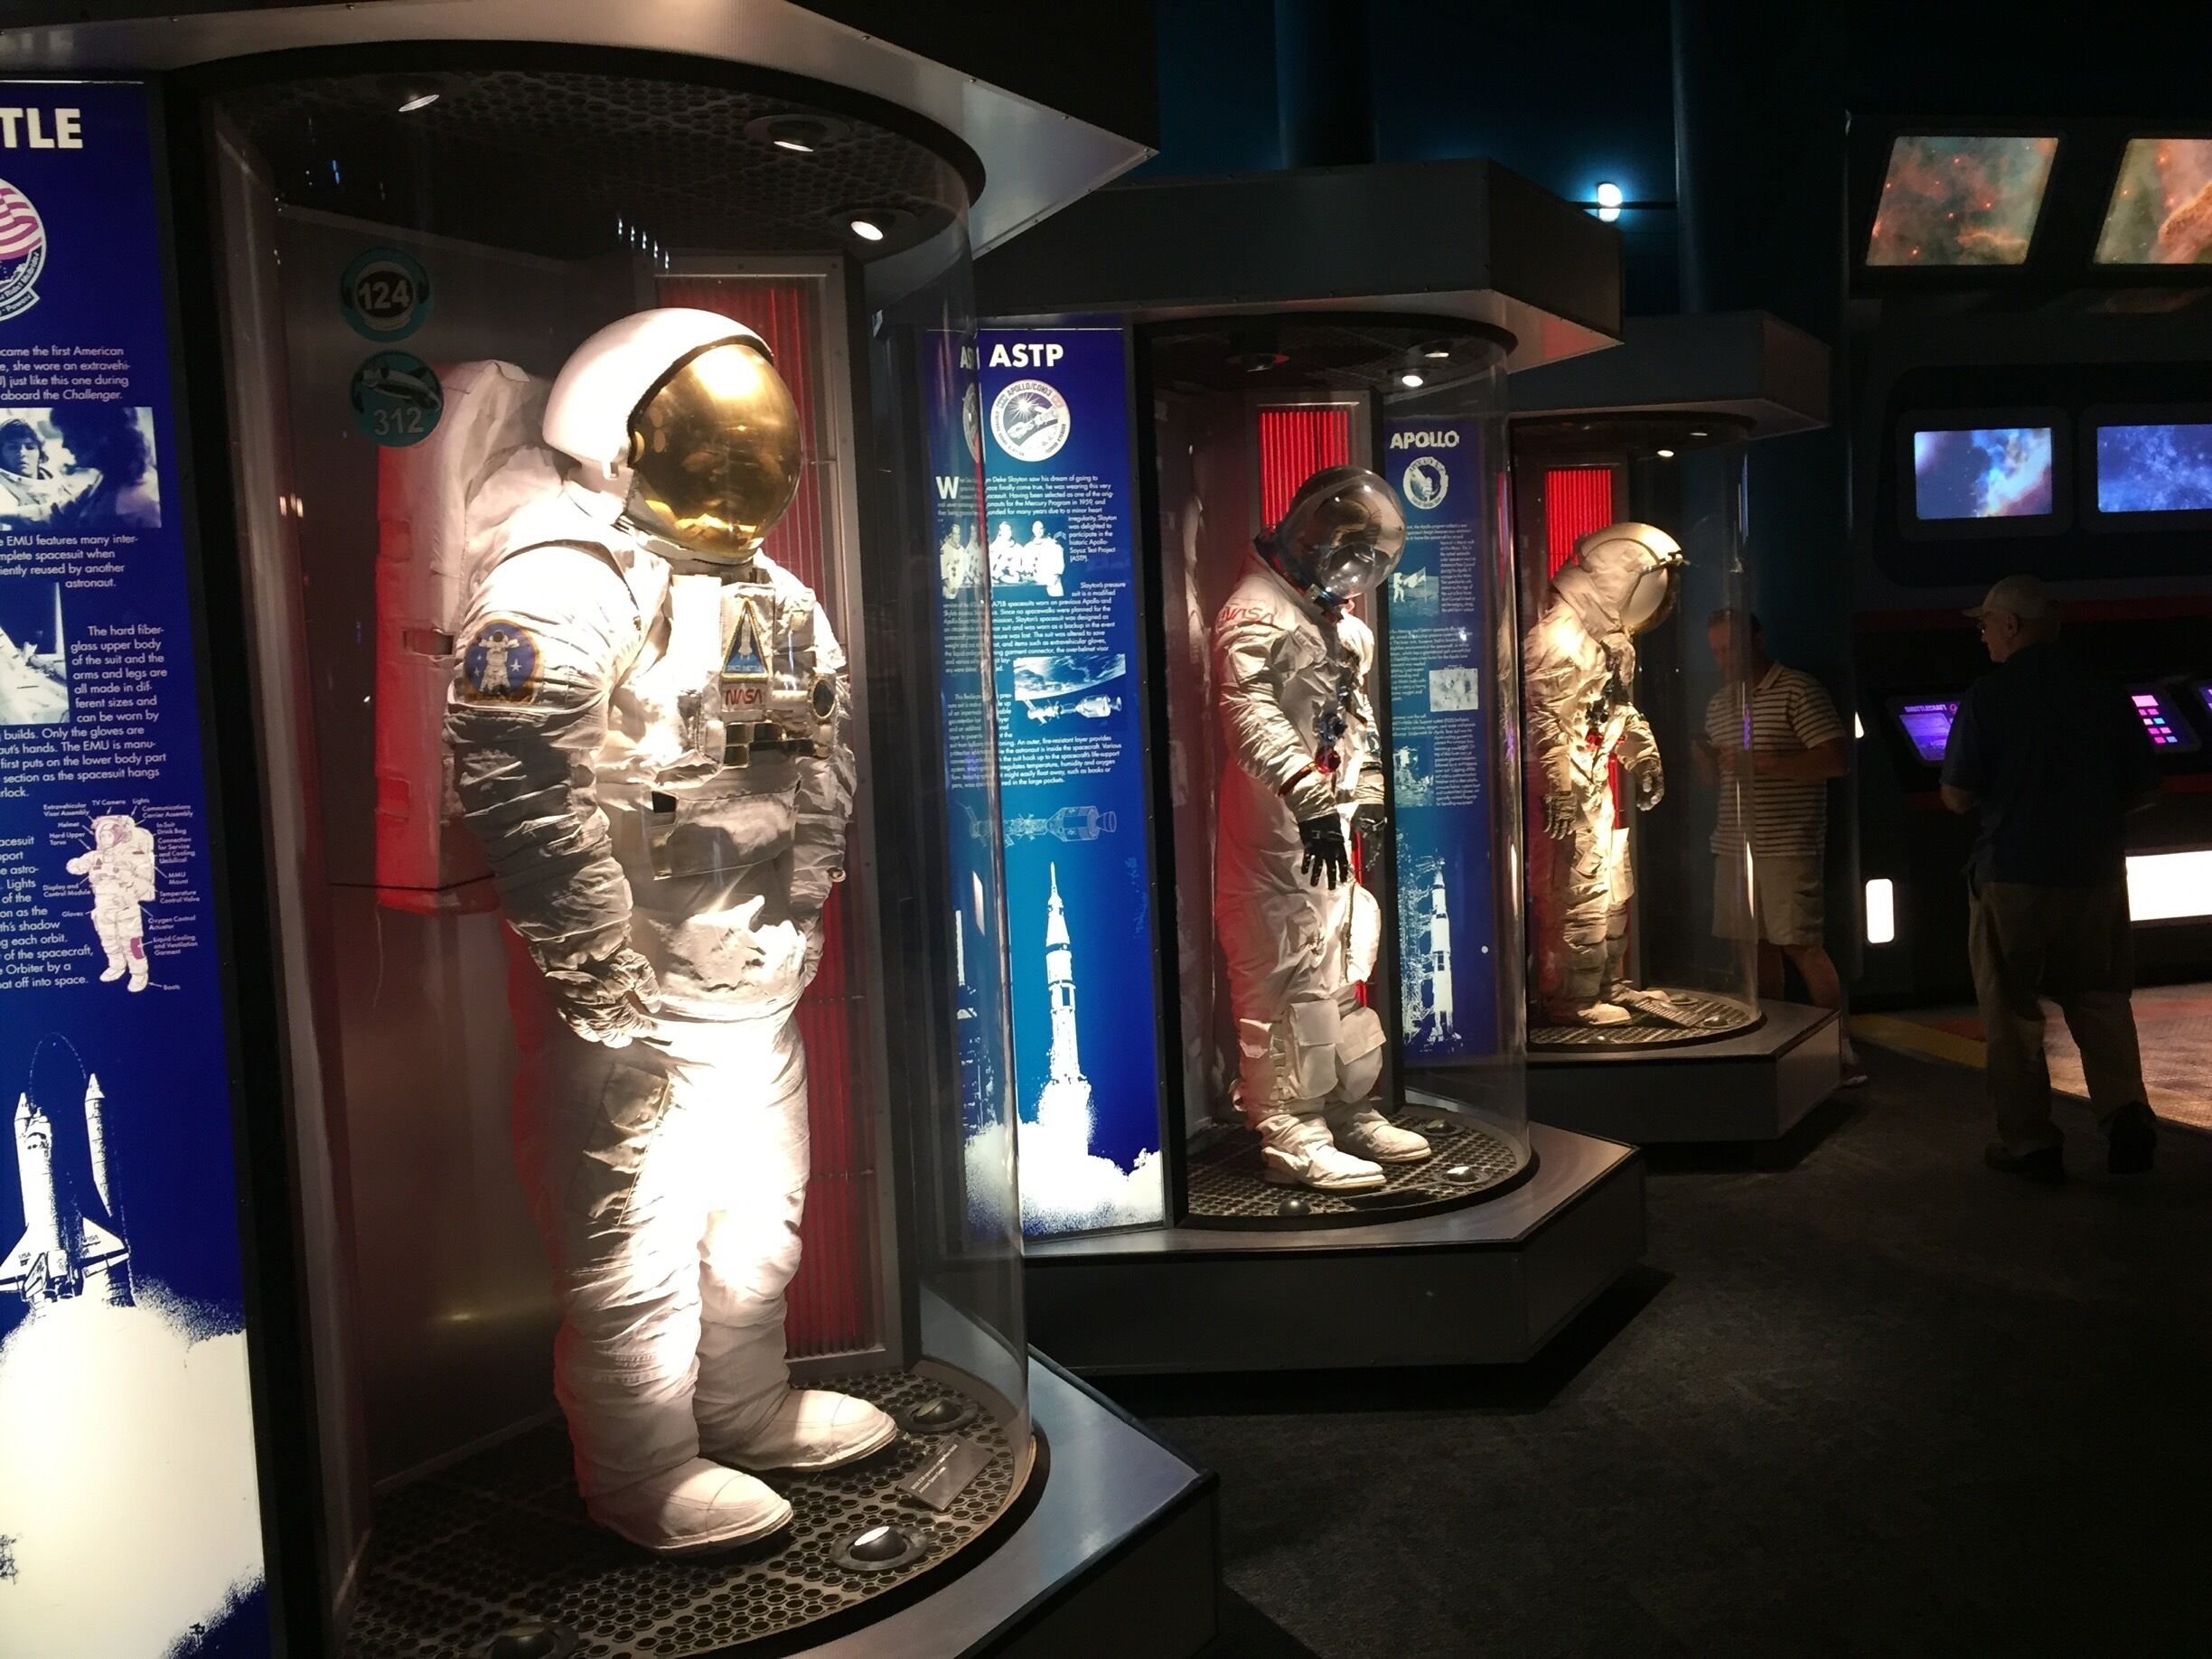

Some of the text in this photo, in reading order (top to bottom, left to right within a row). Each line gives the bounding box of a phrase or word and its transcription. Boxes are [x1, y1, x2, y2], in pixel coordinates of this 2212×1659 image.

[0, 108, 83, 149] TLE
[359, 280, 408, 309] 124
[33, 345, 49, 356] the
[52, 344, 70, 356] first
[73, 345, 124, 356] American
[989, 342, 1064, 368] ASTP
[13, 360, 31, 371] she
[80, 360, 130, 370] extravehi-
[9, 375, 27, 388] just
[30, 374, 48, 385] like
[51, 374, 70, 385] this
[95, 374, 129, 388] during
[1, 389, 123, 402] aboard the Challenger.
[373, 408, 424, 436] 312
[1390, 431, 1459, 449] APOLLO
[6, 535, 33, 547] EMU
[36, 534, 78, 546] features
[80, 537, 109, 547] many
[113, 534, 137, 544] inter-
[35, 549, 84, 562] spacesuit
[86, 548, 116, 559] when
[31, 563, 66, 575] reused
[69, 563, 82, 576] by
[85, 562, 126, 574] another
[65, 579, 117, 588] astronaut.
[1221, 606, 1273, 623] NASA
[88, 623, 164, 636] The hard fiber-
[70, 638, 162, 654] glass upper body
[71, 652, 164, 665] of the suit and the
[73, 667, 167, 680] arms and legs are
[74, 680, 153, 694] all made in dif-
[75, 695, 157, 708] ferent sizes and
[726, 689, 762, 705] NASA
[76, 709, 159, 723] can be worn by
[4, 726, 145, 740] builds. Only the gloves are
[22, 742, 58, 754] hands.
[61, 741, 80, 752] The
[83, 741, 109, 751] EMU
[112, 741, 121, 750] is
[124, 741, 156, 750] manu-
[0, 757, 19, 769] first
[22, 759, 44, 771] puts
[63, 755, 80, 766] the
[82, 754, 111, 765] lower
[114, 752, 142, 765] body
[145, 753, 166, 765] part
[3, 766, 160, 783] section as the spacesuit hangs
[10, 866, 40, 875] astro-
[6, 877, 36, 890] Lights
[2, 892, 32, 904] of the
[32, 905, 48, 916] the
[19, 919, 61, 931] shadow
[11, 933, 68, 945] each orbit.
[4, 944, 93, 961] of the spacecraft,
[5, 961, 71, 975] Orbiter by a
[14, 977, 30, 989] off
[32, 977, 52, 987] into
[54, 977, 89, 989] space.
